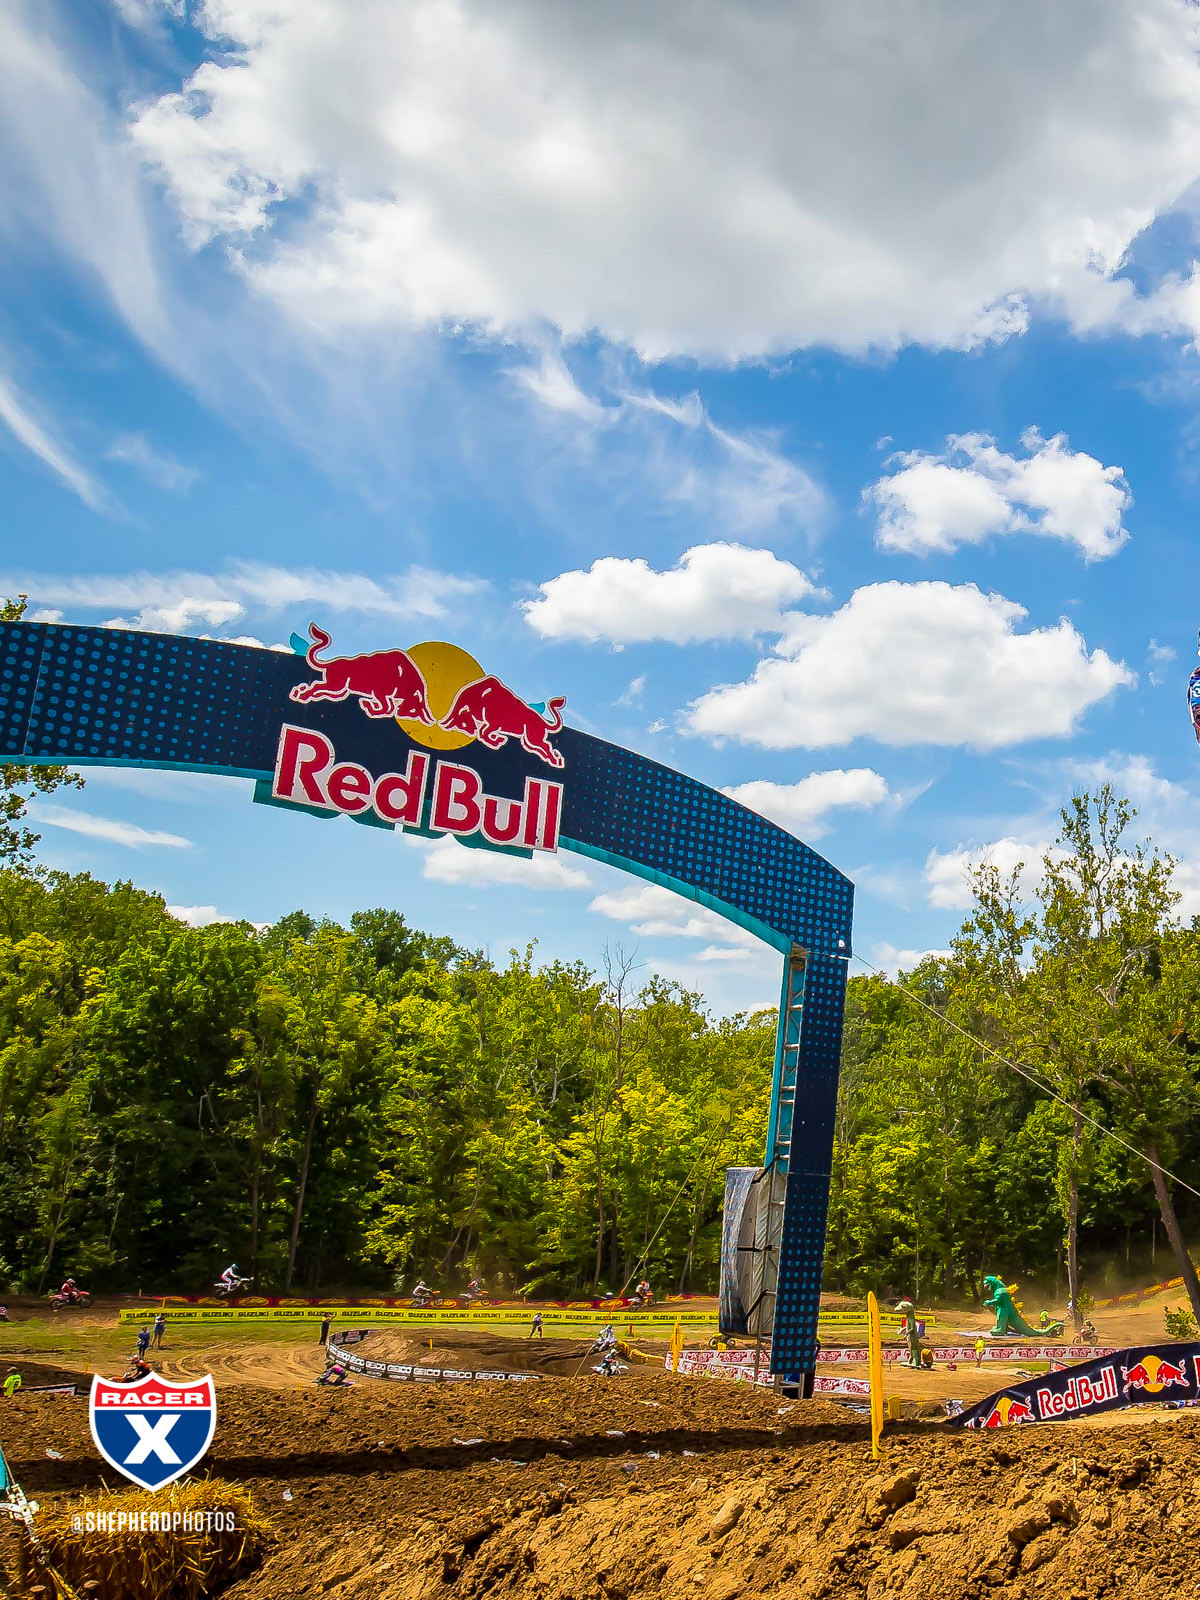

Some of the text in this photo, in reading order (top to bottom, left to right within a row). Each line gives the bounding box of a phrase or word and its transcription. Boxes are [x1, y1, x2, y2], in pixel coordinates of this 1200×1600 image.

[273, 724, 564, 853] Red Bull
[387, 1364, 412, 1374] GEICO
[413, 1367, 440, 1376] GEICO
[443, 1370, 472, 1379] GEICO
[475, 1372, 505, 1380] GEICO
[1037, 1366, 1119, 1420] Red Bull
